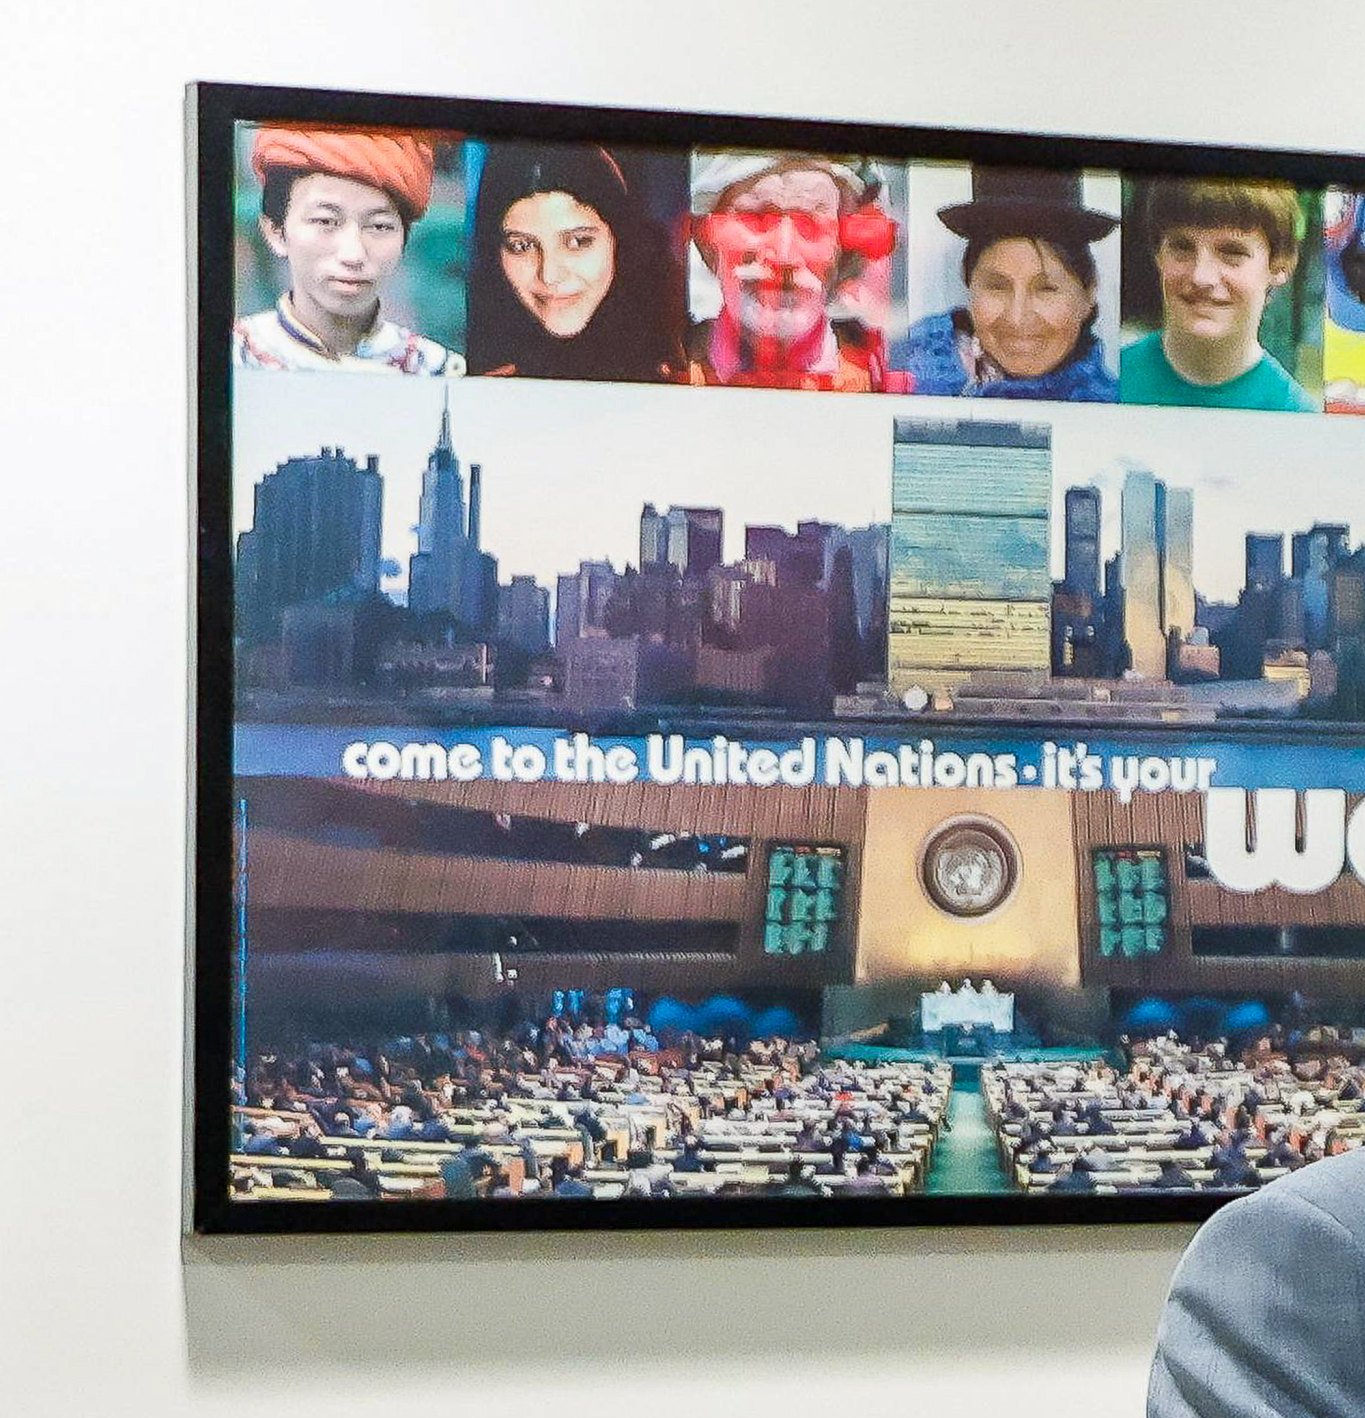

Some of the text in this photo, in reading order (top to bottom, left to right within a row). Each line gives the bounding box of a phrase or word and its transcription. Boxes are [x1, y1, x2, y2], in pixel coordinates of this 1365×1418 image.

[342, 731, 1218, 804] come to the United Nations it's your
